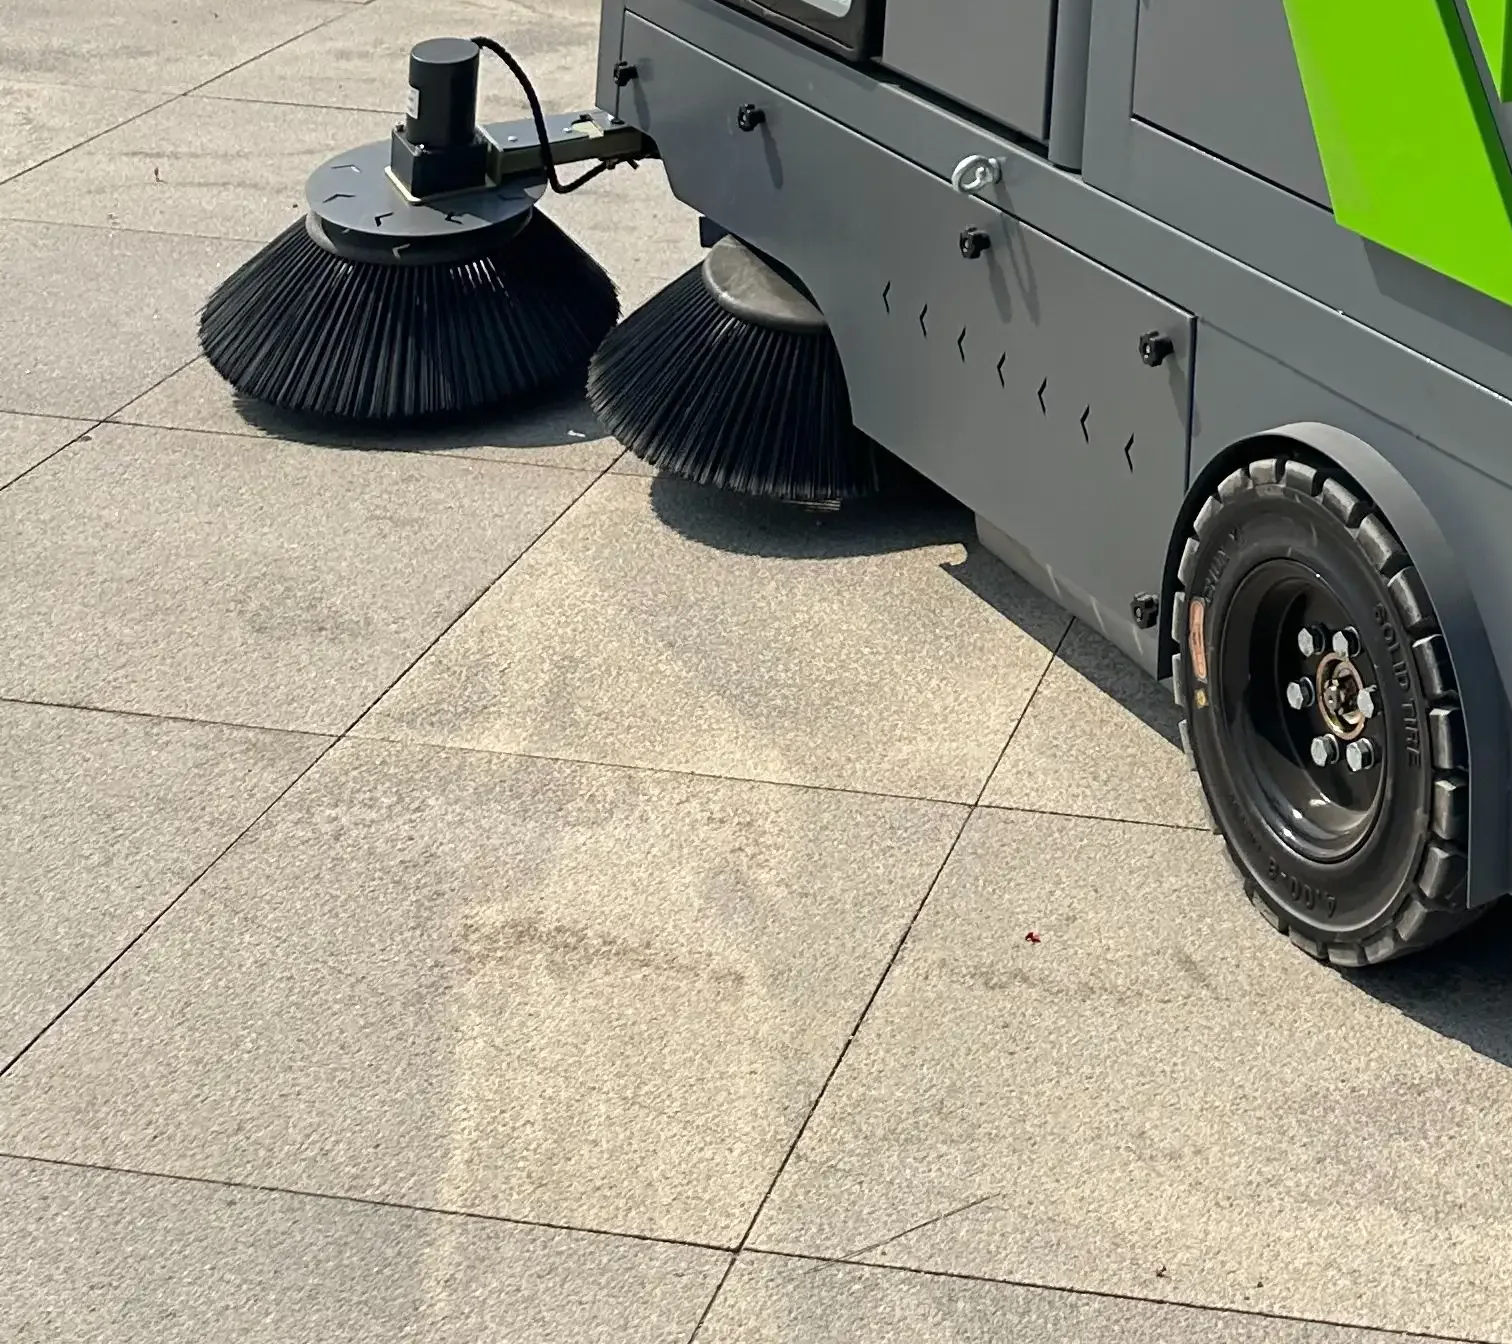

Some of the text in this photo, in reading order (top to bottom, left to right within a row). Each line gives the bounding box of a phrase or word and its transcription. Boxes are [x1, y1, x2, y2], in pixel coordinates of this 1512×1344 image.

[1374, 601, 1422, 769] SOLID TIRE
[1268, 855, 1337, 919] 4.00-8
